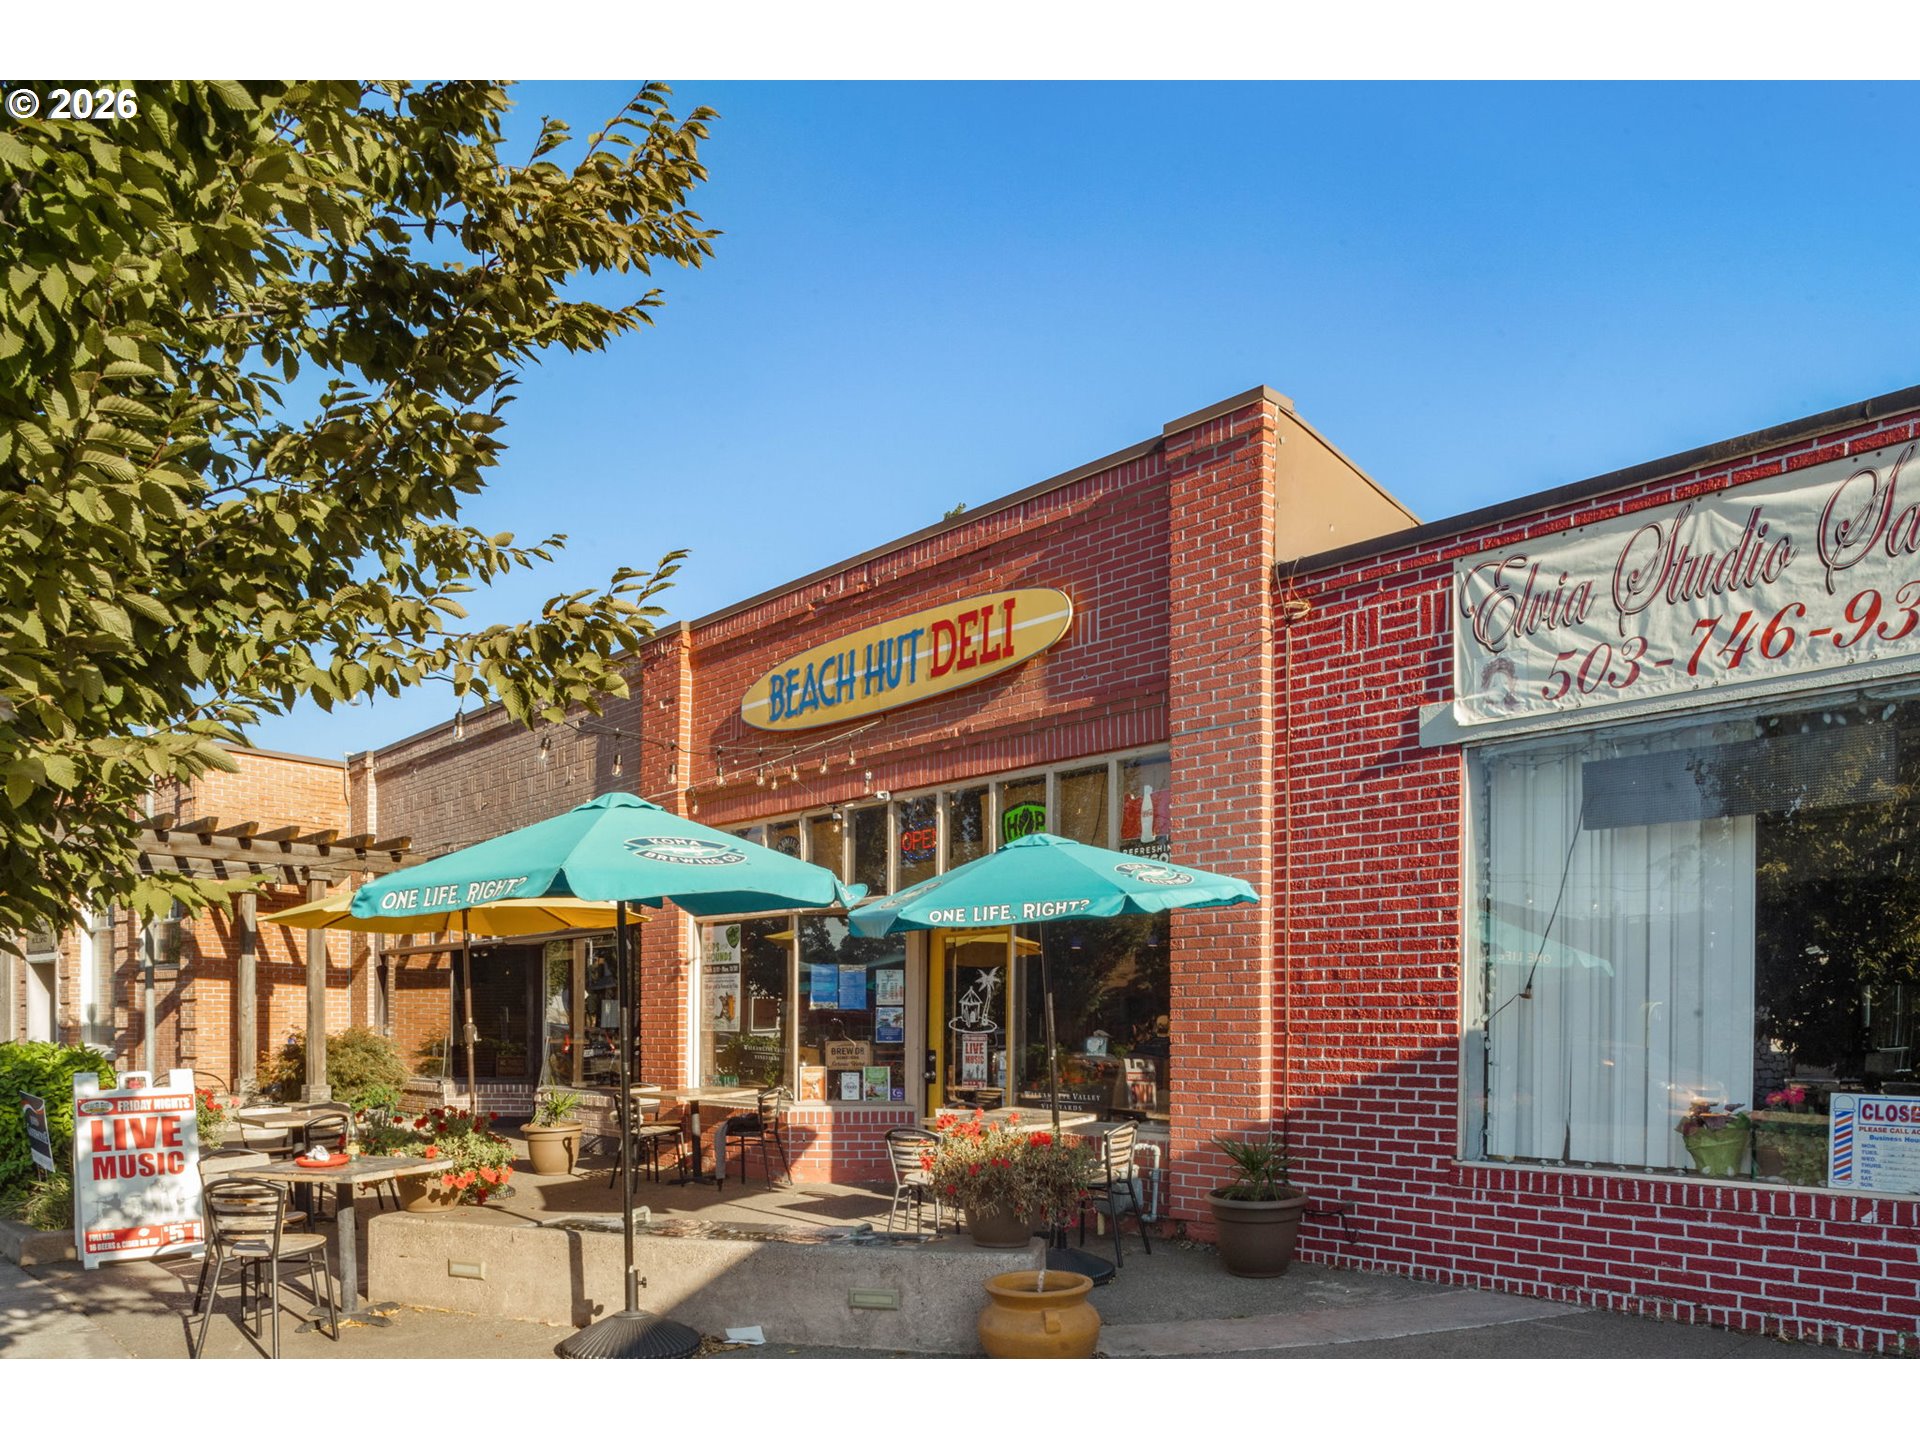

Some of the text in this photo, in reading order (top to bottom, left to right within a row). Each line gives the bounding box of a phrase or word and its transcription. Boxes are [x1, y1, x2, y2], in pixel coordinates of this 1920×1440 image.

[1459, 552, 1597, 653] Elvia
[1612, 500, 1798, 636] Studio
[768, 597, 1016, 722] BEACH HUT DELI
[647, 837, 702, 847] KONA
[644, 851, 724, 865] BREWING
[381, 876, 529, 910] ONE LIFE. RIGHT?
[929, 899, 1091, 923] ONE LIFE. RIGHT?
[831, 1047, 854, 1055] BREW
[117, 1099, 152, 1113] FRIDAY
[153, 1097, 191, 1111] NIGHTS
[91, 1115, 184, 1153] LIVE
[1859, 1126, 1887, 1134] PLEASE
[1890, 1127, 1909, 1135] CALL
[1869, 1134, 1902, 1143] Business
[92, 1150, 185, 1181] MUSIC
